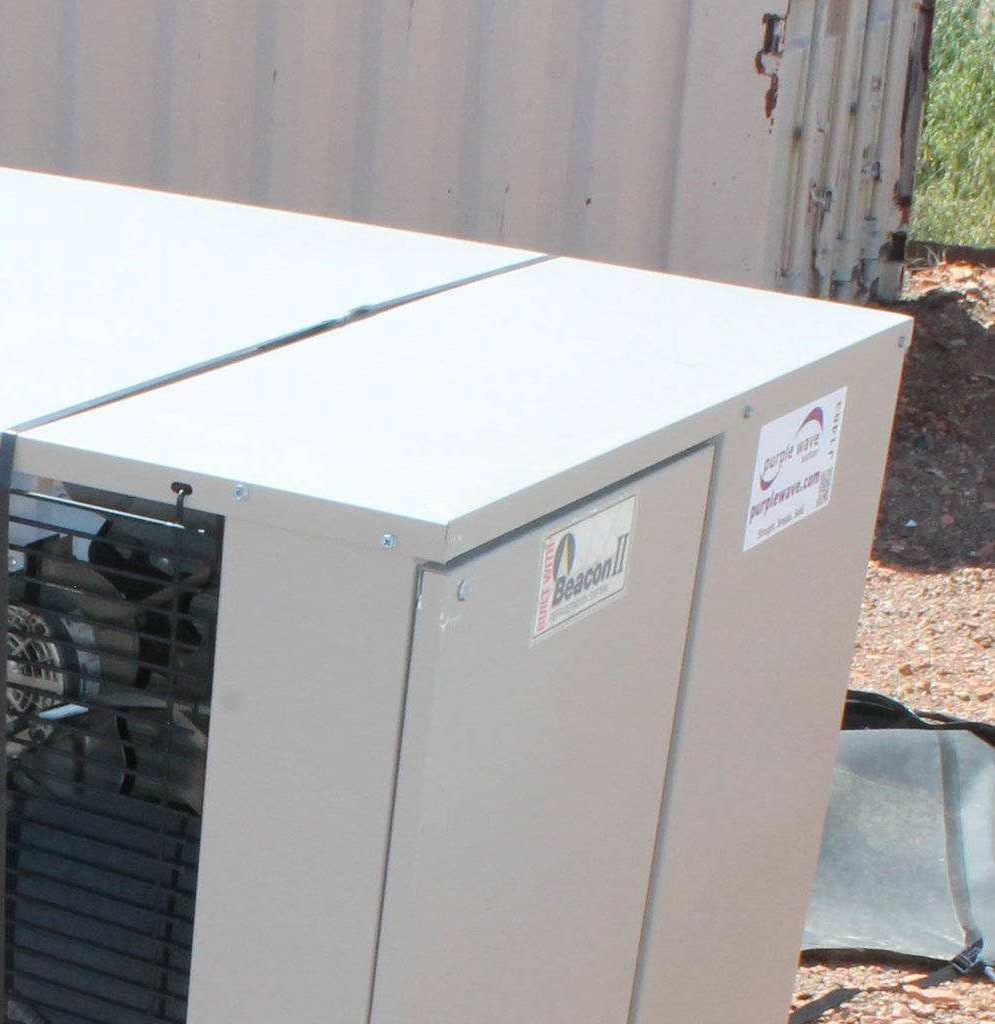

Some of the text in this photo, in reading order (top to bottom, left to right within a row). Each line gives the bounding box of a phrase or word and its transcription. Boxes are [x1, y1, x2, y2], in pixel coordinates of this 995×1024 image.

[763, 442, 794, 473] purple
[796, 432, 820, 453] wave
[749, 470, 821, 525] purplewave.com
[543, 542, 555, 585] WITH
[552, 556, 613, 607] Beacon
